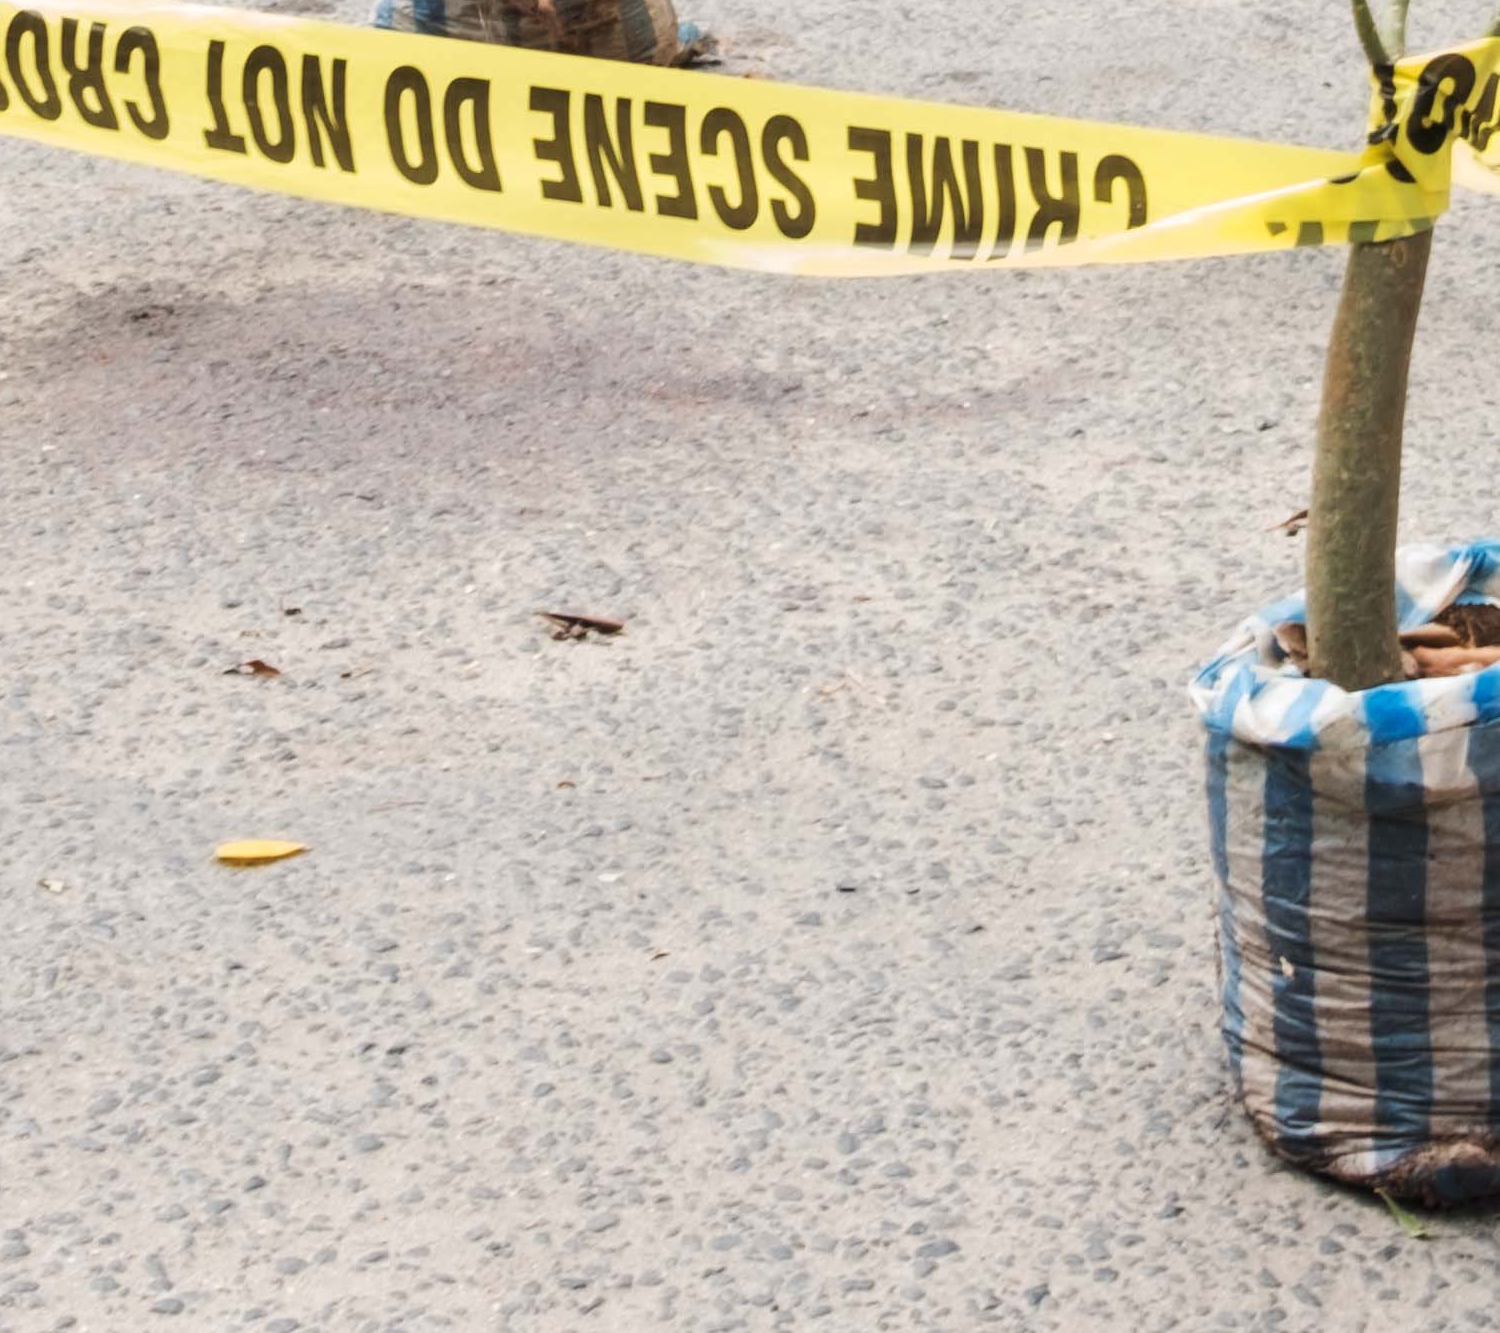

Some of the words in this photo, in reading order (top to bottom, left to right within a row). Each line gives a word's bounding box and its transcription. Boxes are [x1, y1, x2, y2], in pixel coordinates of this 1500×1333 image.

[203, 38, 357, 173] NOT
[383, 65, 503, 193] DO
[527, 85, 817, 240] SCENE
[846, 124, 1149, 261] CRIME
